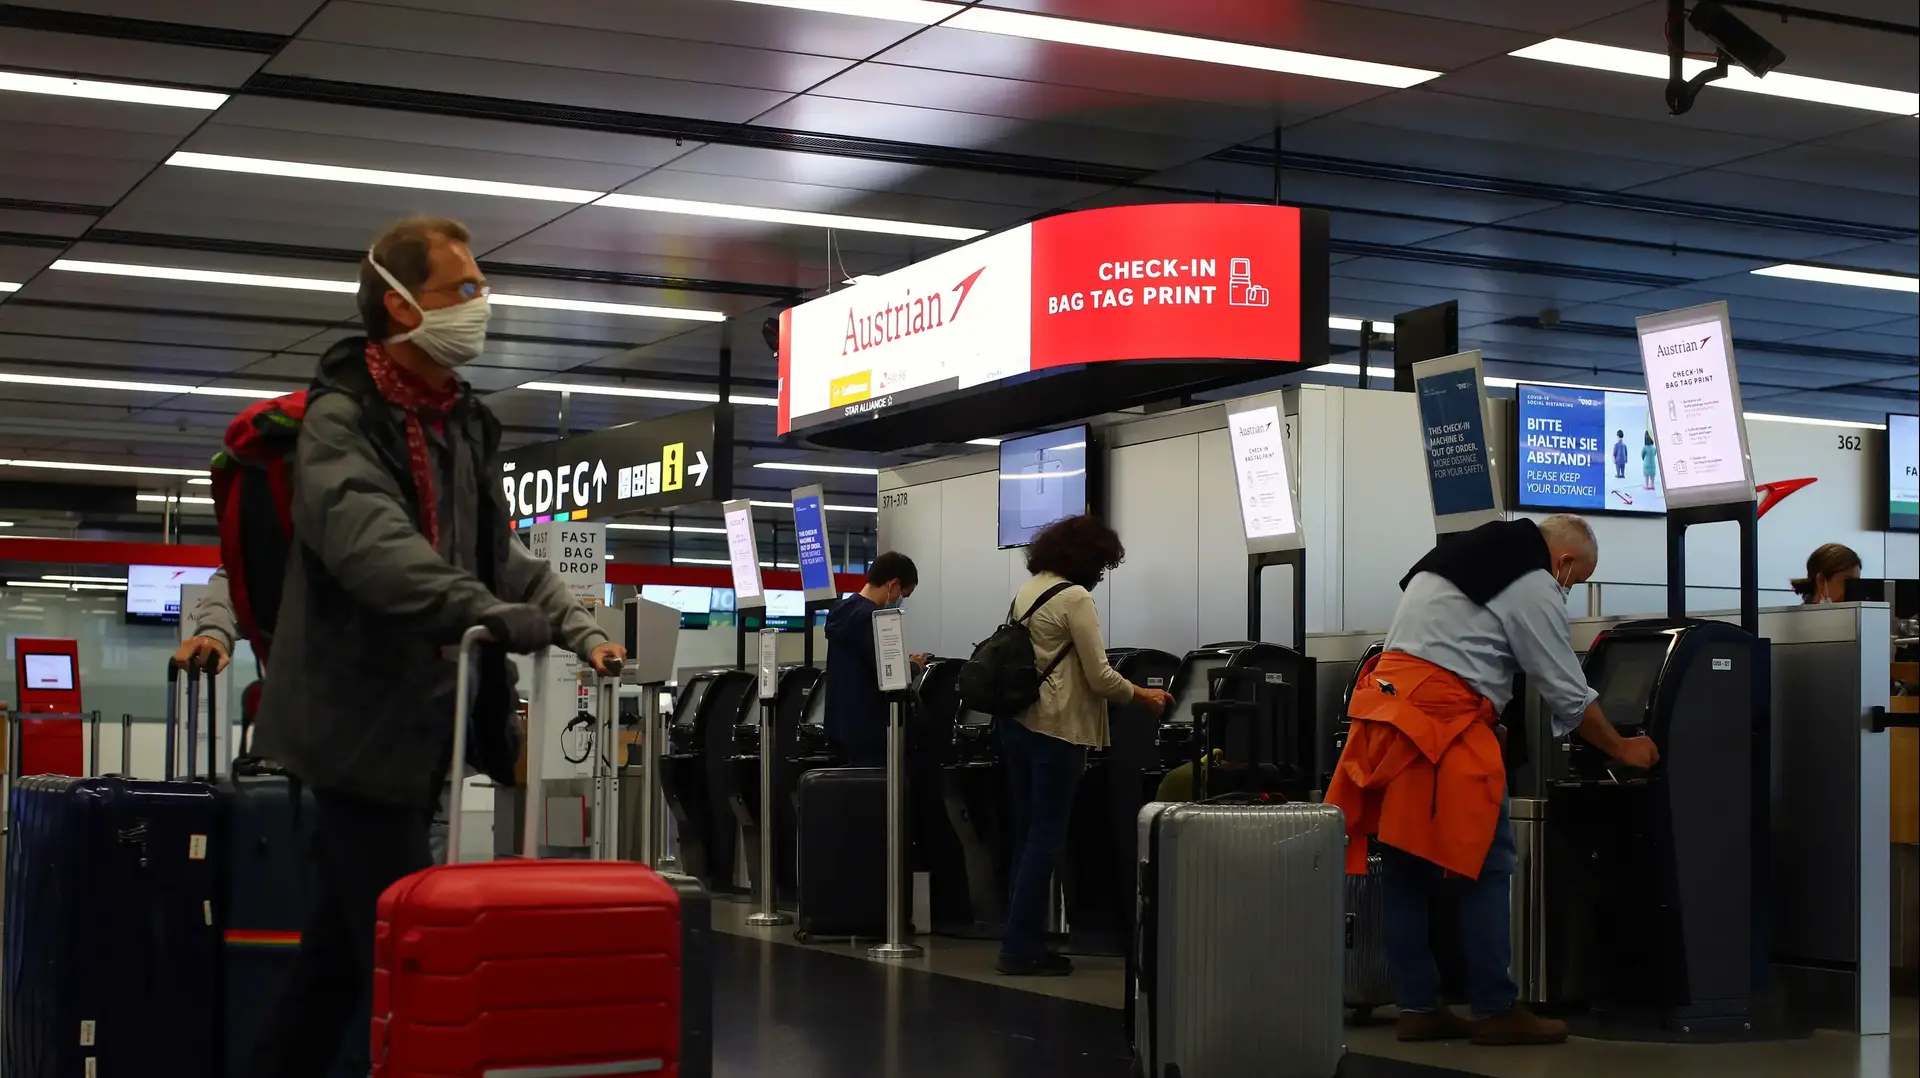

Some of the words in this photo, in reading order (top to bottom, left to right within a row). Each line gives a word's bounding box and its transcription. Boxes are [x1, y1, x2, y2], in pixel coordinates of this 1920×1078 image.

[1098, 258, 1216, 281] CHECK-IN
[1049, 292, 1084, 315] BAG
[1090, 287, 1134, 309] TAG
[1143, 285, 1217, 305] PRINT
[842, 289, 943, 355] Austrian
[1657, 340, 1698, 357] Austrian
[1672, 367, 1703, 379] CHECK-IN
[1665, 381, 1678, 389] BAG
[1680, 378, 1693, 387] TAG
[1694, 375, 1713, 386] PRINT
[844, 403, 859, 416] STAR
[859, 397, 886, 413] ALLIANCE
[1239, 424, 1265, 437] Austrian
[1428, 425, 1442, 436] THIS
[1443, 421, 1470, 434] CHECK-IN
[1527, 417, 1563, 432] BITTE
[1430, 435, 1457, 446] MACHINE
[1458, 433, 1464, 442] IS
[1527, 434, 1576, 449] HALTEN
[1579, 438, 1598, 451] SIE
[1838, 435, 1861, 450] 362
[1431, 447, 1444, 457] OUT
[1446, 446, 1454, 455] OF
[1455, 442, 1478, 454] ORDER.
[1433, 457, 1450, 468] MORE
[1451, 453, 1477, 466] DISTANCE
[1527, 451, 1591, 467] ABSTAND!
[1435, 469, 1447, 479] FOR
[1447, 466, 1464, 477] YOUR
[1464, 463, 1484, 475] SAFETY.
[1527, 470, 1558, 482] PLEASE
[1559, 472, 1580, 483] KEEP
[1526, 483, 1551, 494] YOUR
[1553, 484, 1596, 496] DISTANCE!
[883, 492, 908, 508] 371-378
[533, 532, 548, 544] FAST
[561, 532, 597, 543] FAST
[564, 547, 593, 558] BAG
[559, 562, 599, 573] DROP
